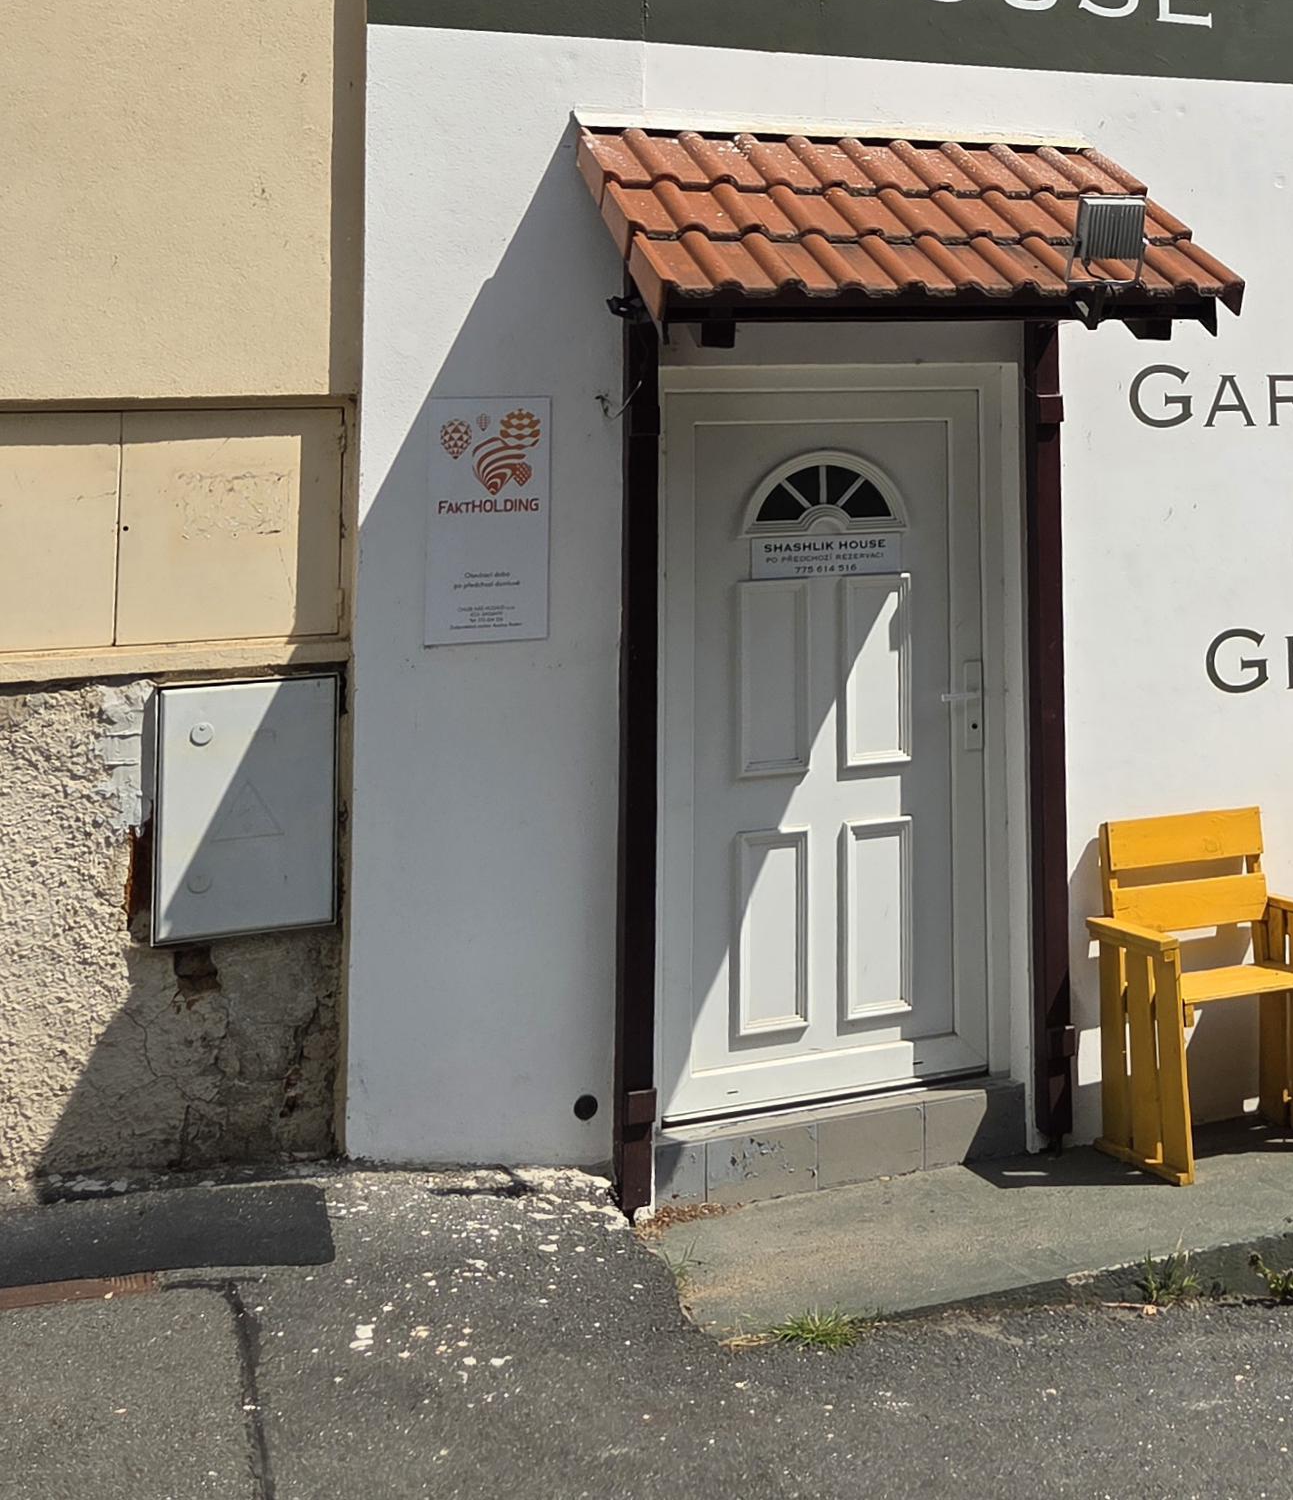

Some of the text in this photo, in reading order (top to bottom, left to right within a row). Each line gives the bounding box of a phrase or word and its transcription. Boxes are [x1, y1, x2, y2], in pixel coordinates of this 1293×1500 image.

[438, 498, 539, 514] FAKTHOLDING
[764, 539, 886, 553] SHASHLIK HOUSE
